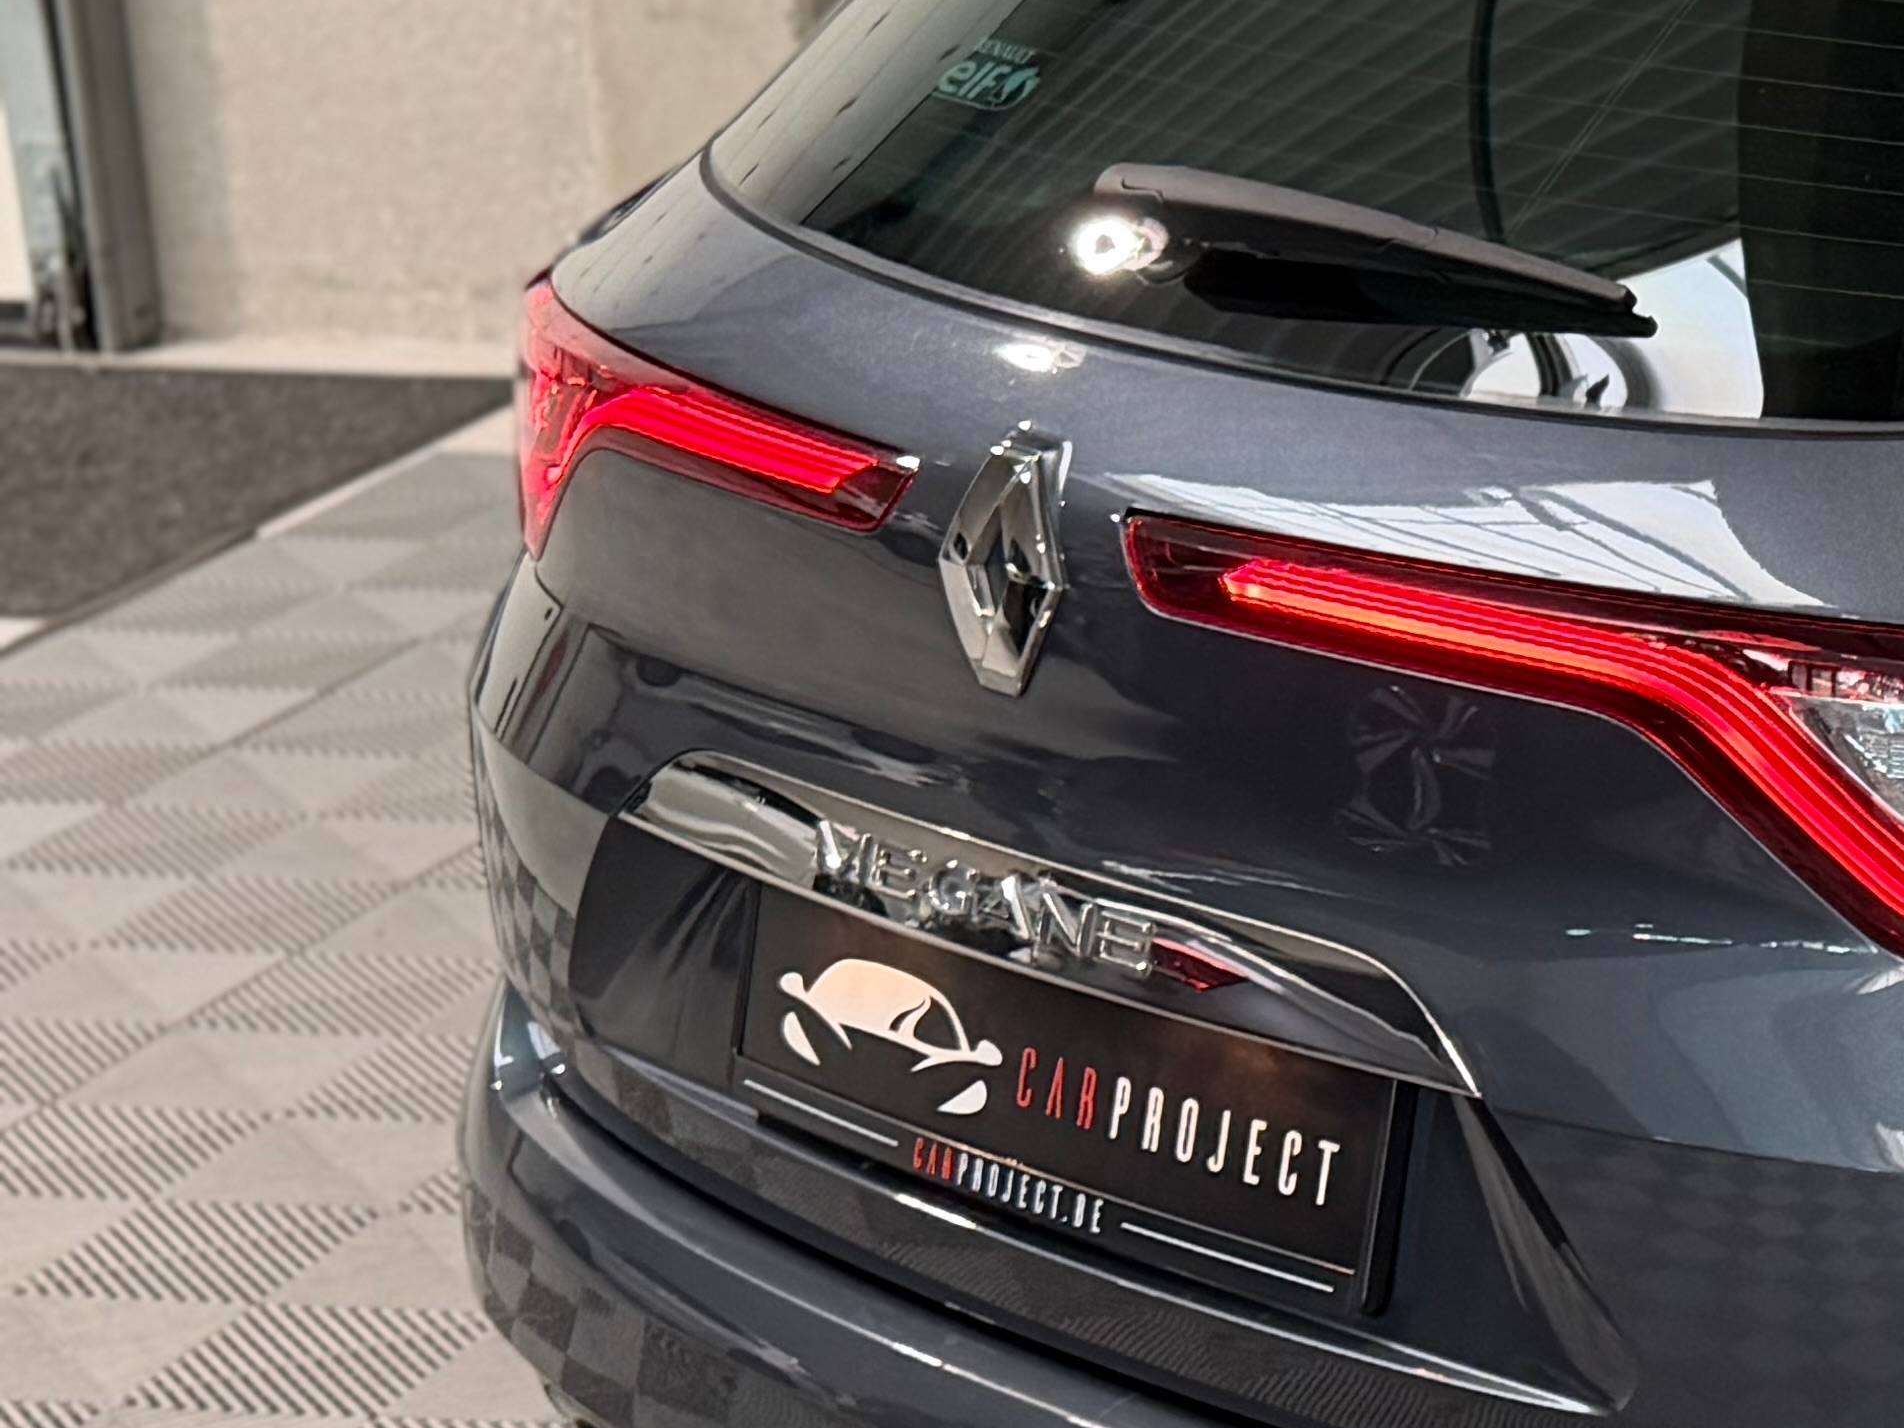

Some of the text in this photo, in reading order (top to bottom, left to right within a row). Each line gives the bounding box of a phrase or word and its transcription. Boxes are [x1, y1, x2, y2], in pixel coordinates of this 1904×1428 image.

[814, 819, 1156, 978] MEGANE
[912, 1136, 1104, 1234] CARPROJECT.DE
[1015, 1046, 1342, 1207] CARPROJECT
